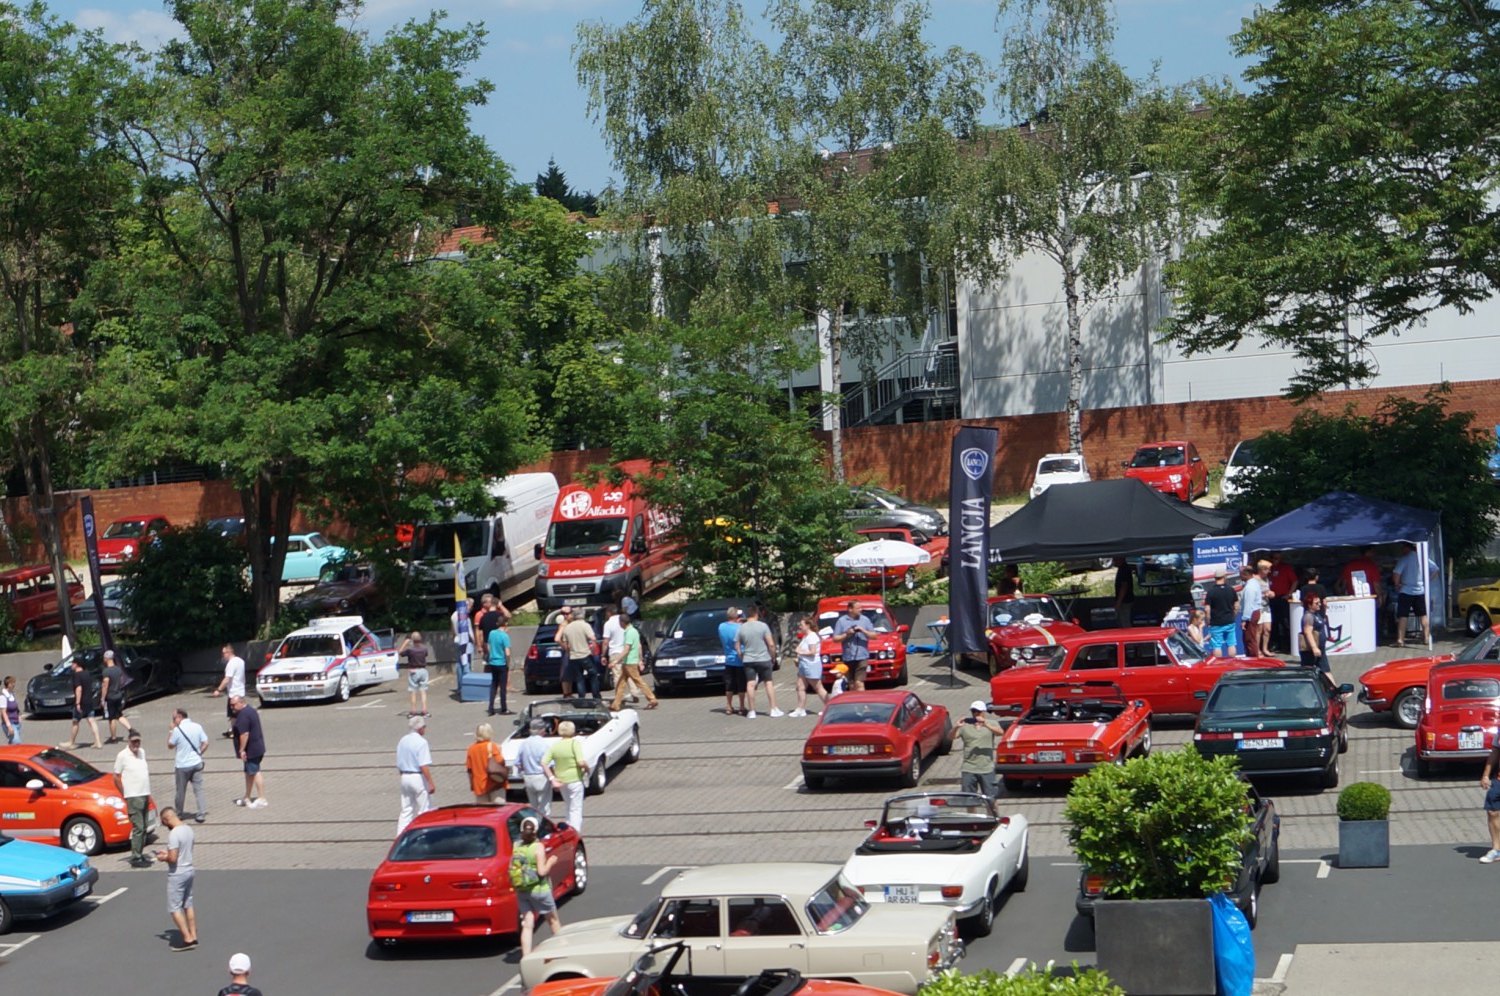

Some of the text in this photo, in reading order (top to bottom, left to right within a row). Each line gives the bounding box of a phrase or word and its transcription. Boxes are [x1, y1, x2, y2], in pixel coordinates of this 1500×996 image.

[961, 497, 985, 570] LANCIA
[370, 663, 377, 676] 4
[895, 887, 908, 896] HU
